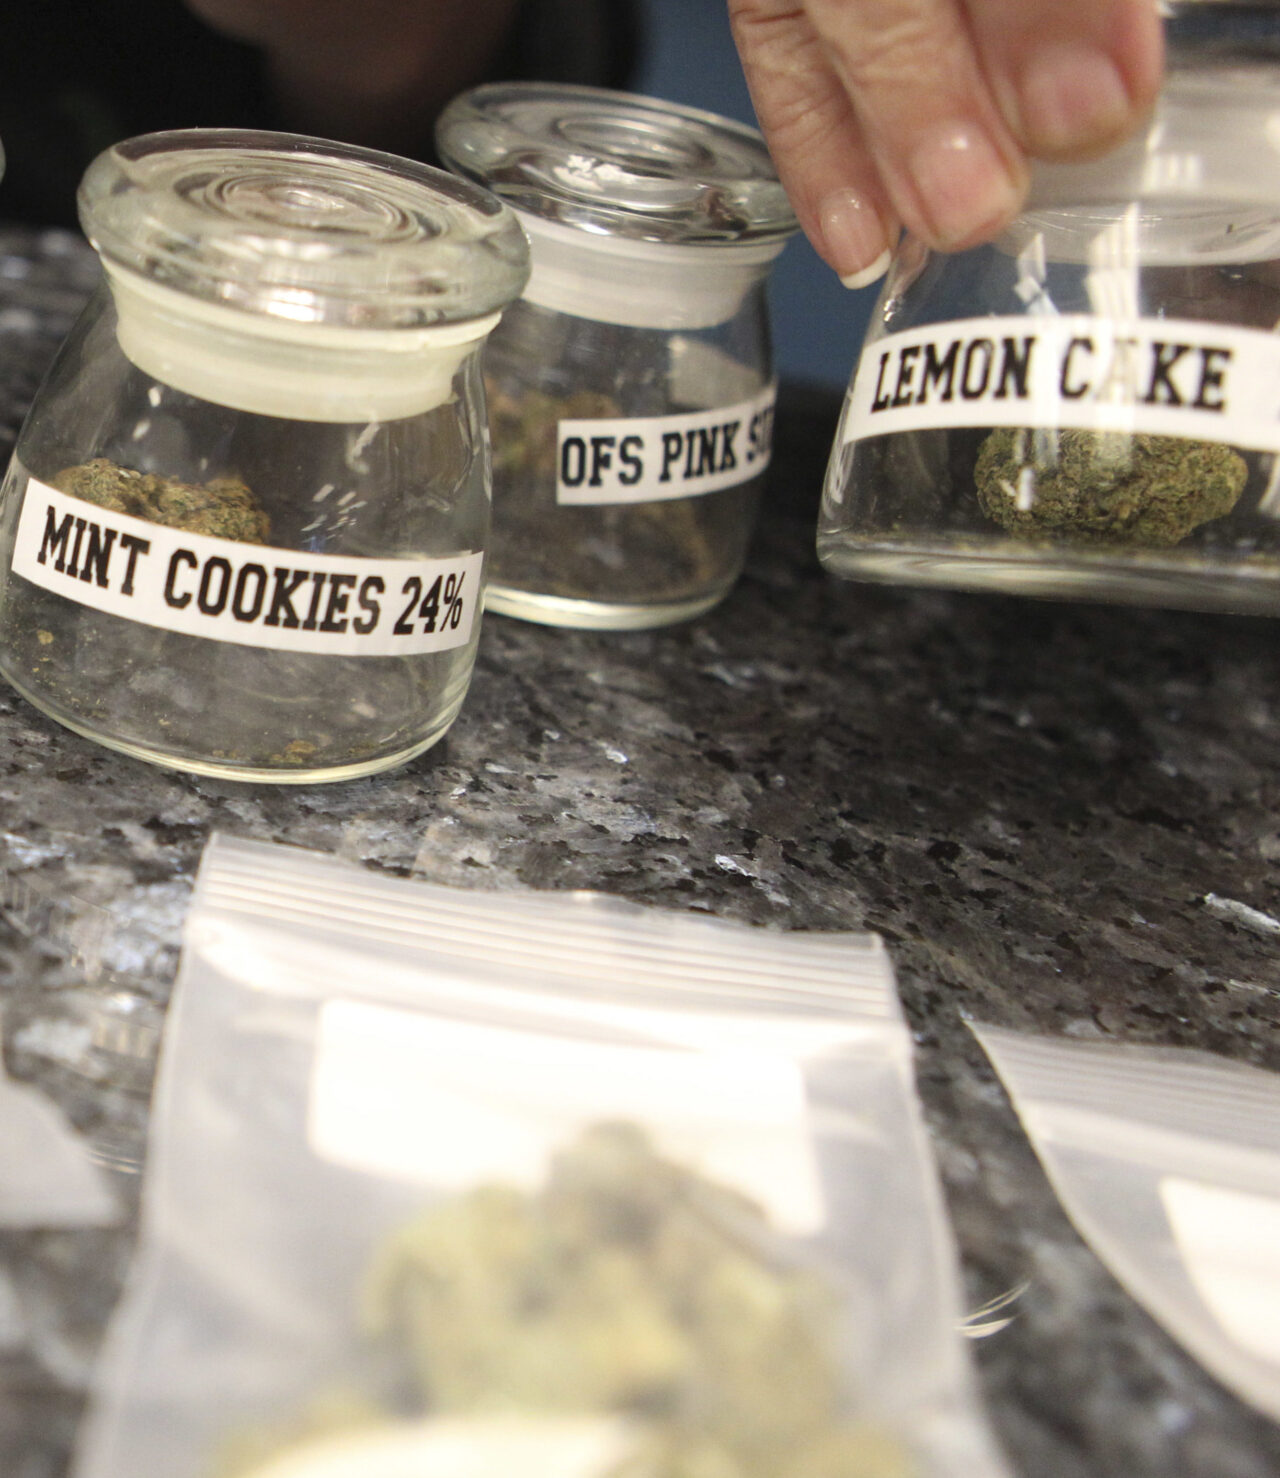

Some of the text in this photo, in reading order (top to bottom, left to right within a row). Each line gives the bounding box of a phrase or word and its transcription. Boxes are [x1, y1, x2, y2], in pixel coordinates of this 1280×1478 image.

[871, 335, 1037, 414] LEMON
[561, 436, 644, 487] OFS
[658, 420, 741, 483] PINK
[37, 505, 466, 636] MINT COOKIES 24%
